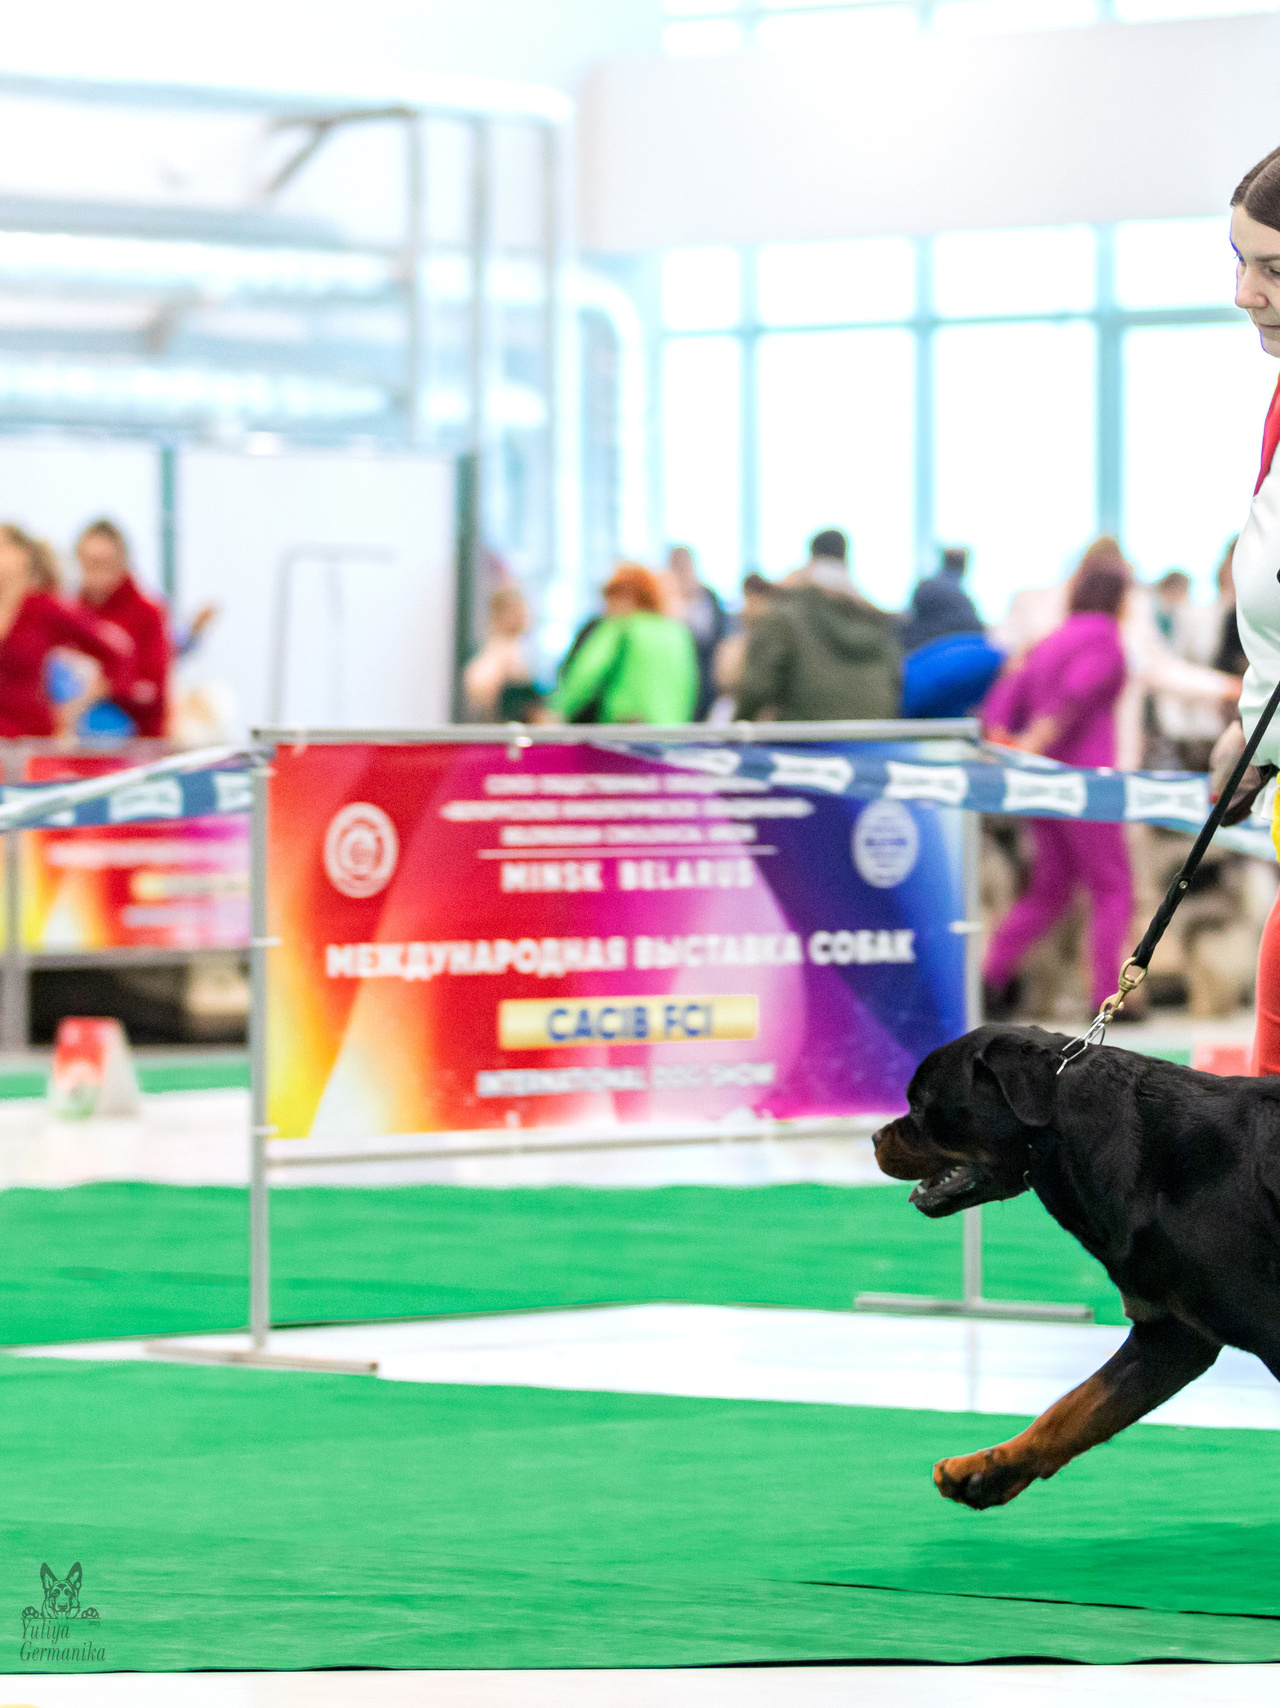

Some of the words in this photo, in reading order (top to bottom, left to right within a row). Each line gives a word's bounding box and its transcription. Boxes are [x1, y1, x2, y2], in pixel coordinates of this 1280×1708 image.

[502, 860, 602, 891] MINSK
[619, 858, 753, 889] BELARUS
[325, 936, 627, 981] МЕЖДУНАРОДНАЯ
[634, 931, 802, 970] ВЫСТАВКА
[809, 928, 916, 966] СОБАК
[546, 1006, 649, 1041] CACIB
[664, 1004, 712, 1037] FCI
